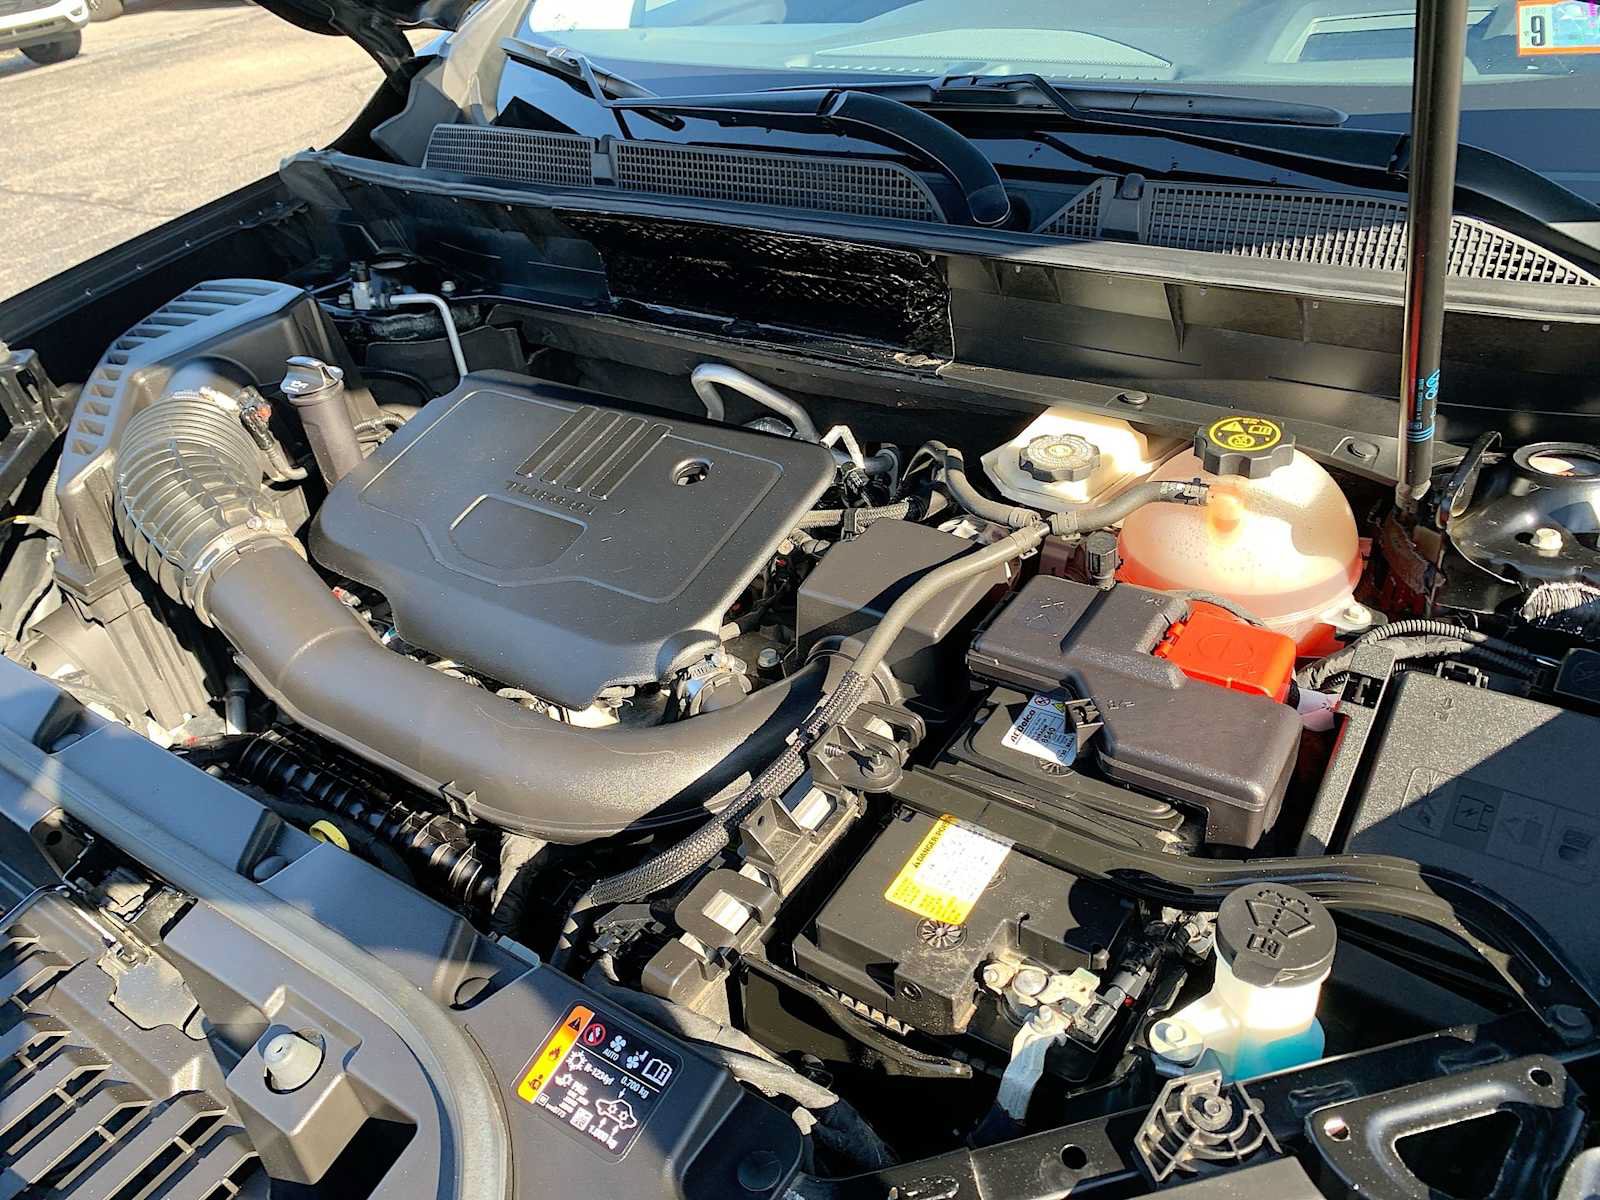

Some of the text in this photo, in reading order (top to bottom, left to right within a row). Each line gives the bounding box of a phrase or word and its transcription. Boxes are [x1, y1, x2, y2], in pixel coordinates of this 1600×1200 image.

[1531, 15, 1545, 46] 9
[602, 1048, 619, 1061] AUTO
[584, 1063, 614, 1085] R-1234yf
[620, 1076, 650, 1100] 0.700 kg
